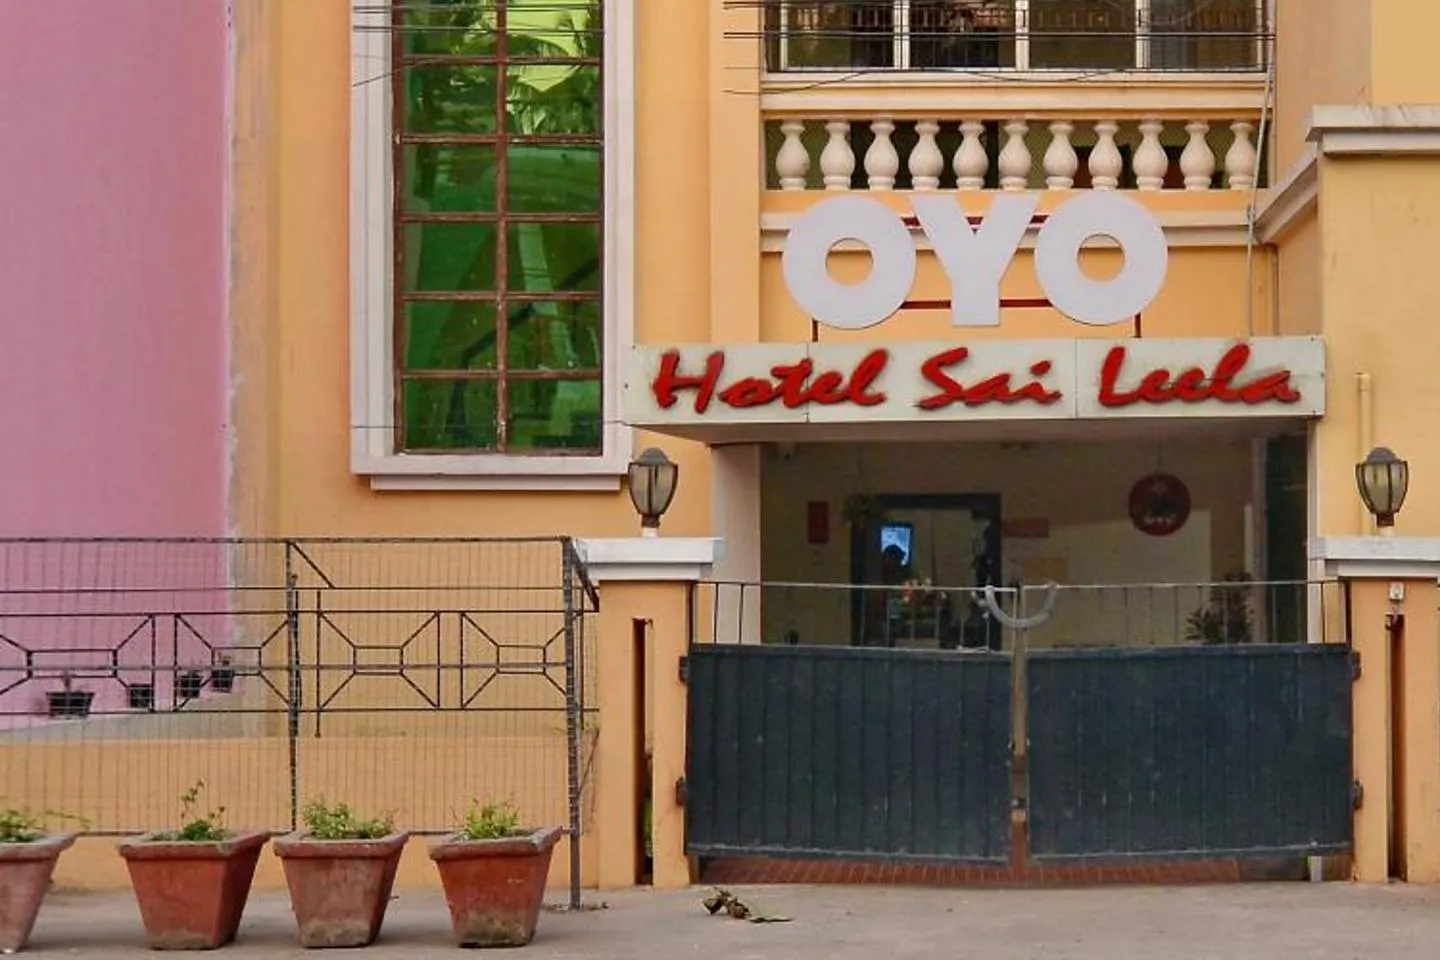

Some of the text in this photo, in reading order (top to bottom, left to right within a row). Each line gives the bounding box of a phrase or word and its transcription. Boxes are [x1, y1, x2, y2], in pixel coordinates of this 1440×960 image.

[782, 192, 1168, 329] OYO
[651, 343, 1301, 415] Hotel Sai Leela
